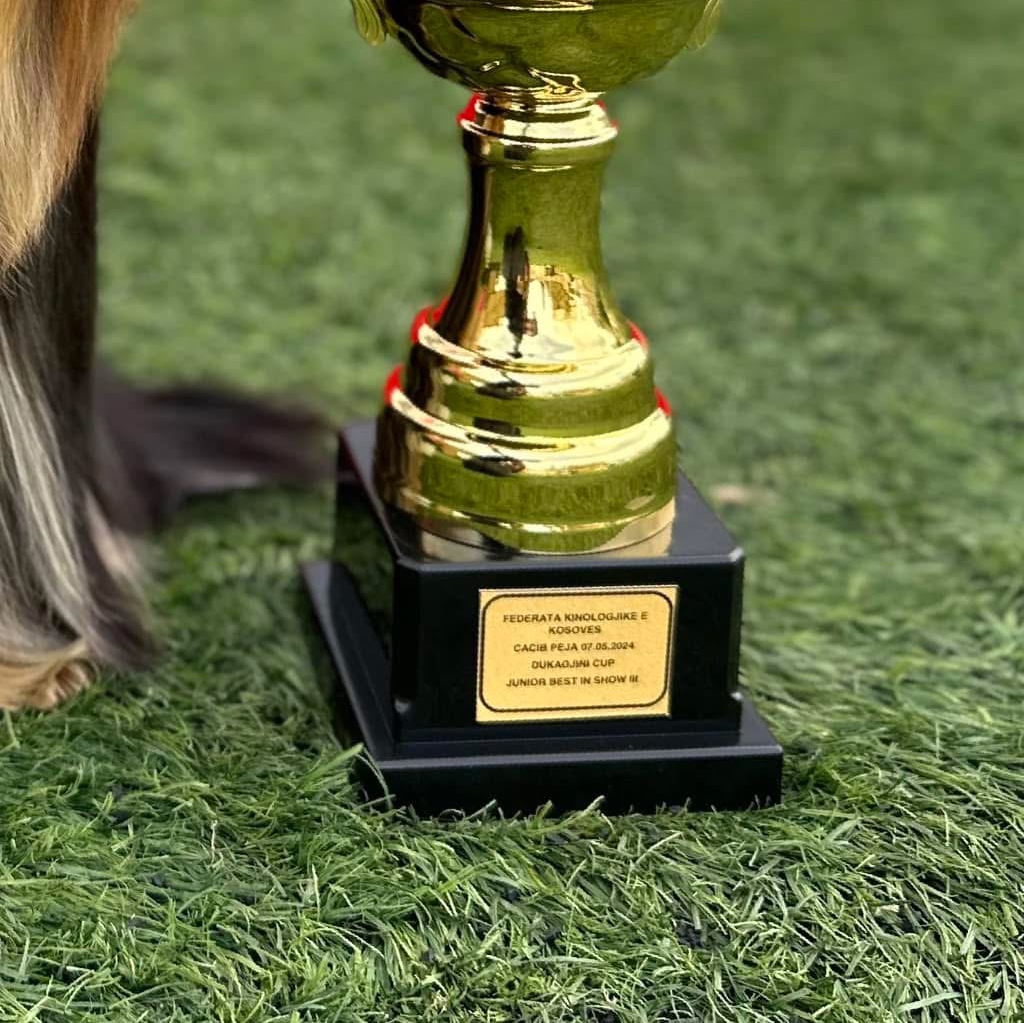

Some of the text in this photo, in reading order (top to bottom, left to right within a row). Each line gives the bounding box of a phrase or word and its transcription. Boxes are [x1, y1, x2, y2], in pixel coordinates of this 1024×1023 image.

[503, 612, 648, 623] FEDERATA KINOLOGJIKE E
[549, 625, 601, 634] KOSOVES
[514, 644, 547, 652] CACIB
[550, 643, 578, 651] PEJA
[593, 659, 615, 667] CUP
[506, 678, 546, 686] JUNIOR
[549, 677, 577, 686] BEST
[581, 676, 591, 685] IN
[594, 675, 626, 684] SHOW
